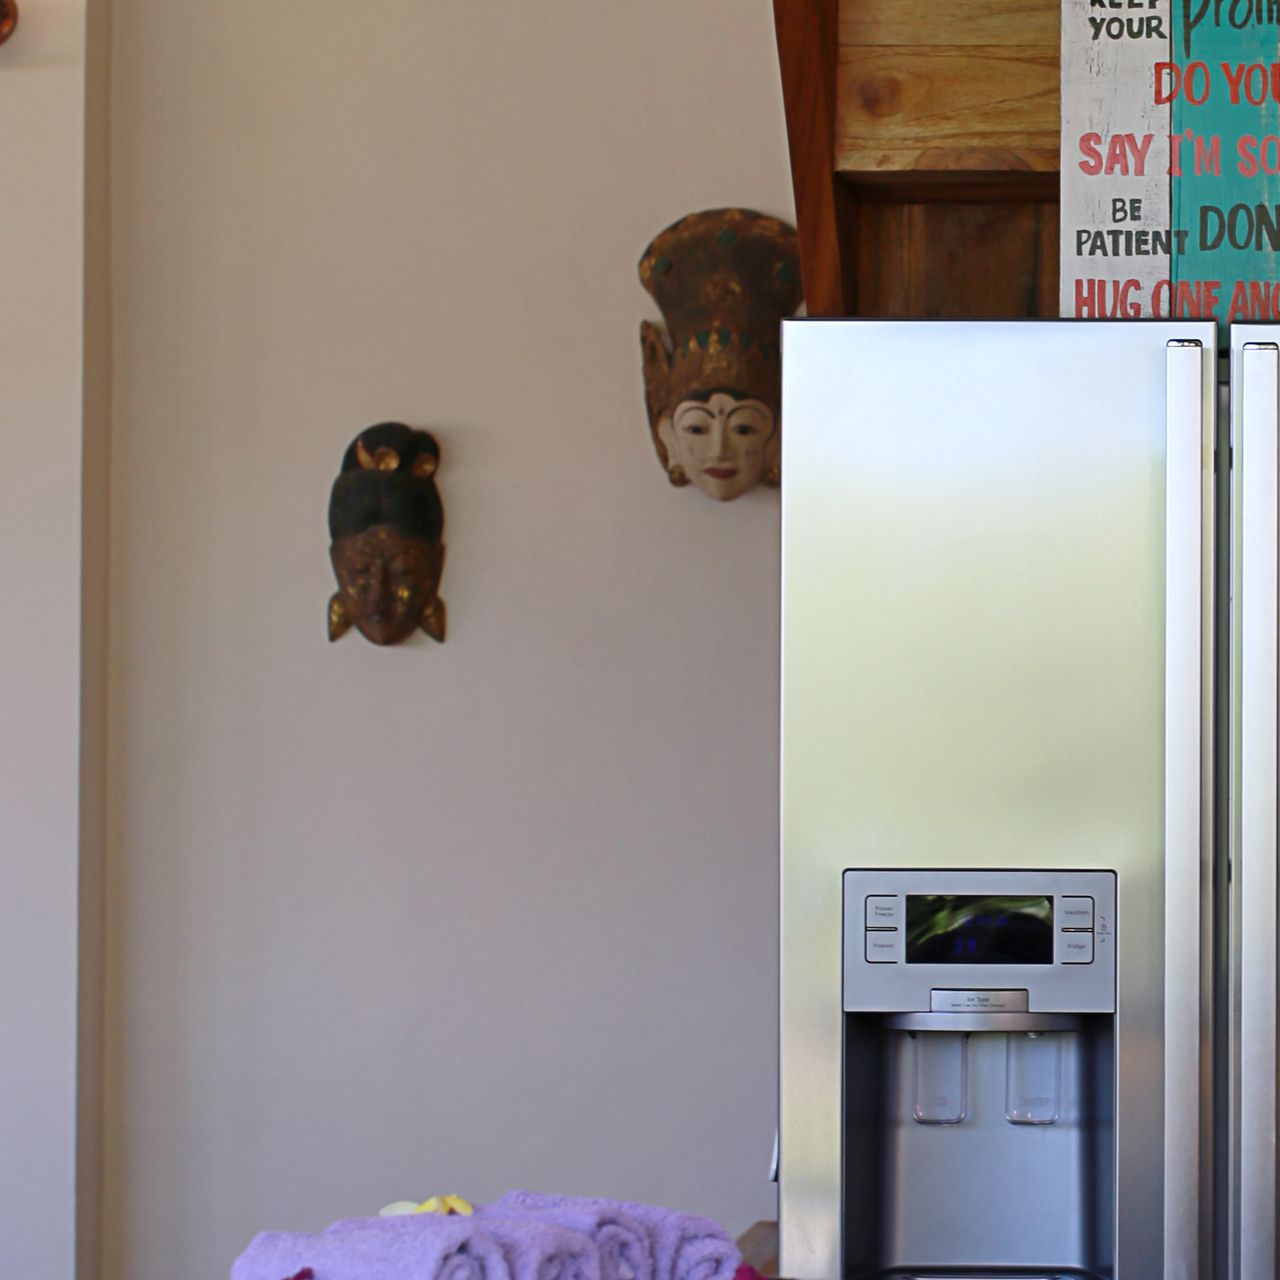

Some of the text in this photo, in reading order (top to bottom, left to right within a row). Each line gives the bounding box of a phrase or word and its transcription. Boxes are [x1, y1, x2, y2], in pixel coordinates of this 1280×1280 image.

[1087, 15, 1168, 41] YOUR
[1153, 61, 1211, 106] DO
[1077, 132, 1155, 178] SAY
[1166, 129, 1222, 178] I'M
[1112, 198, 1142, 223] BE
[1075, 228, 1189, 257] PATIENT
[1074, 278, 1143, 319] HUG
[1151, 278, 1222, 320] ONE
